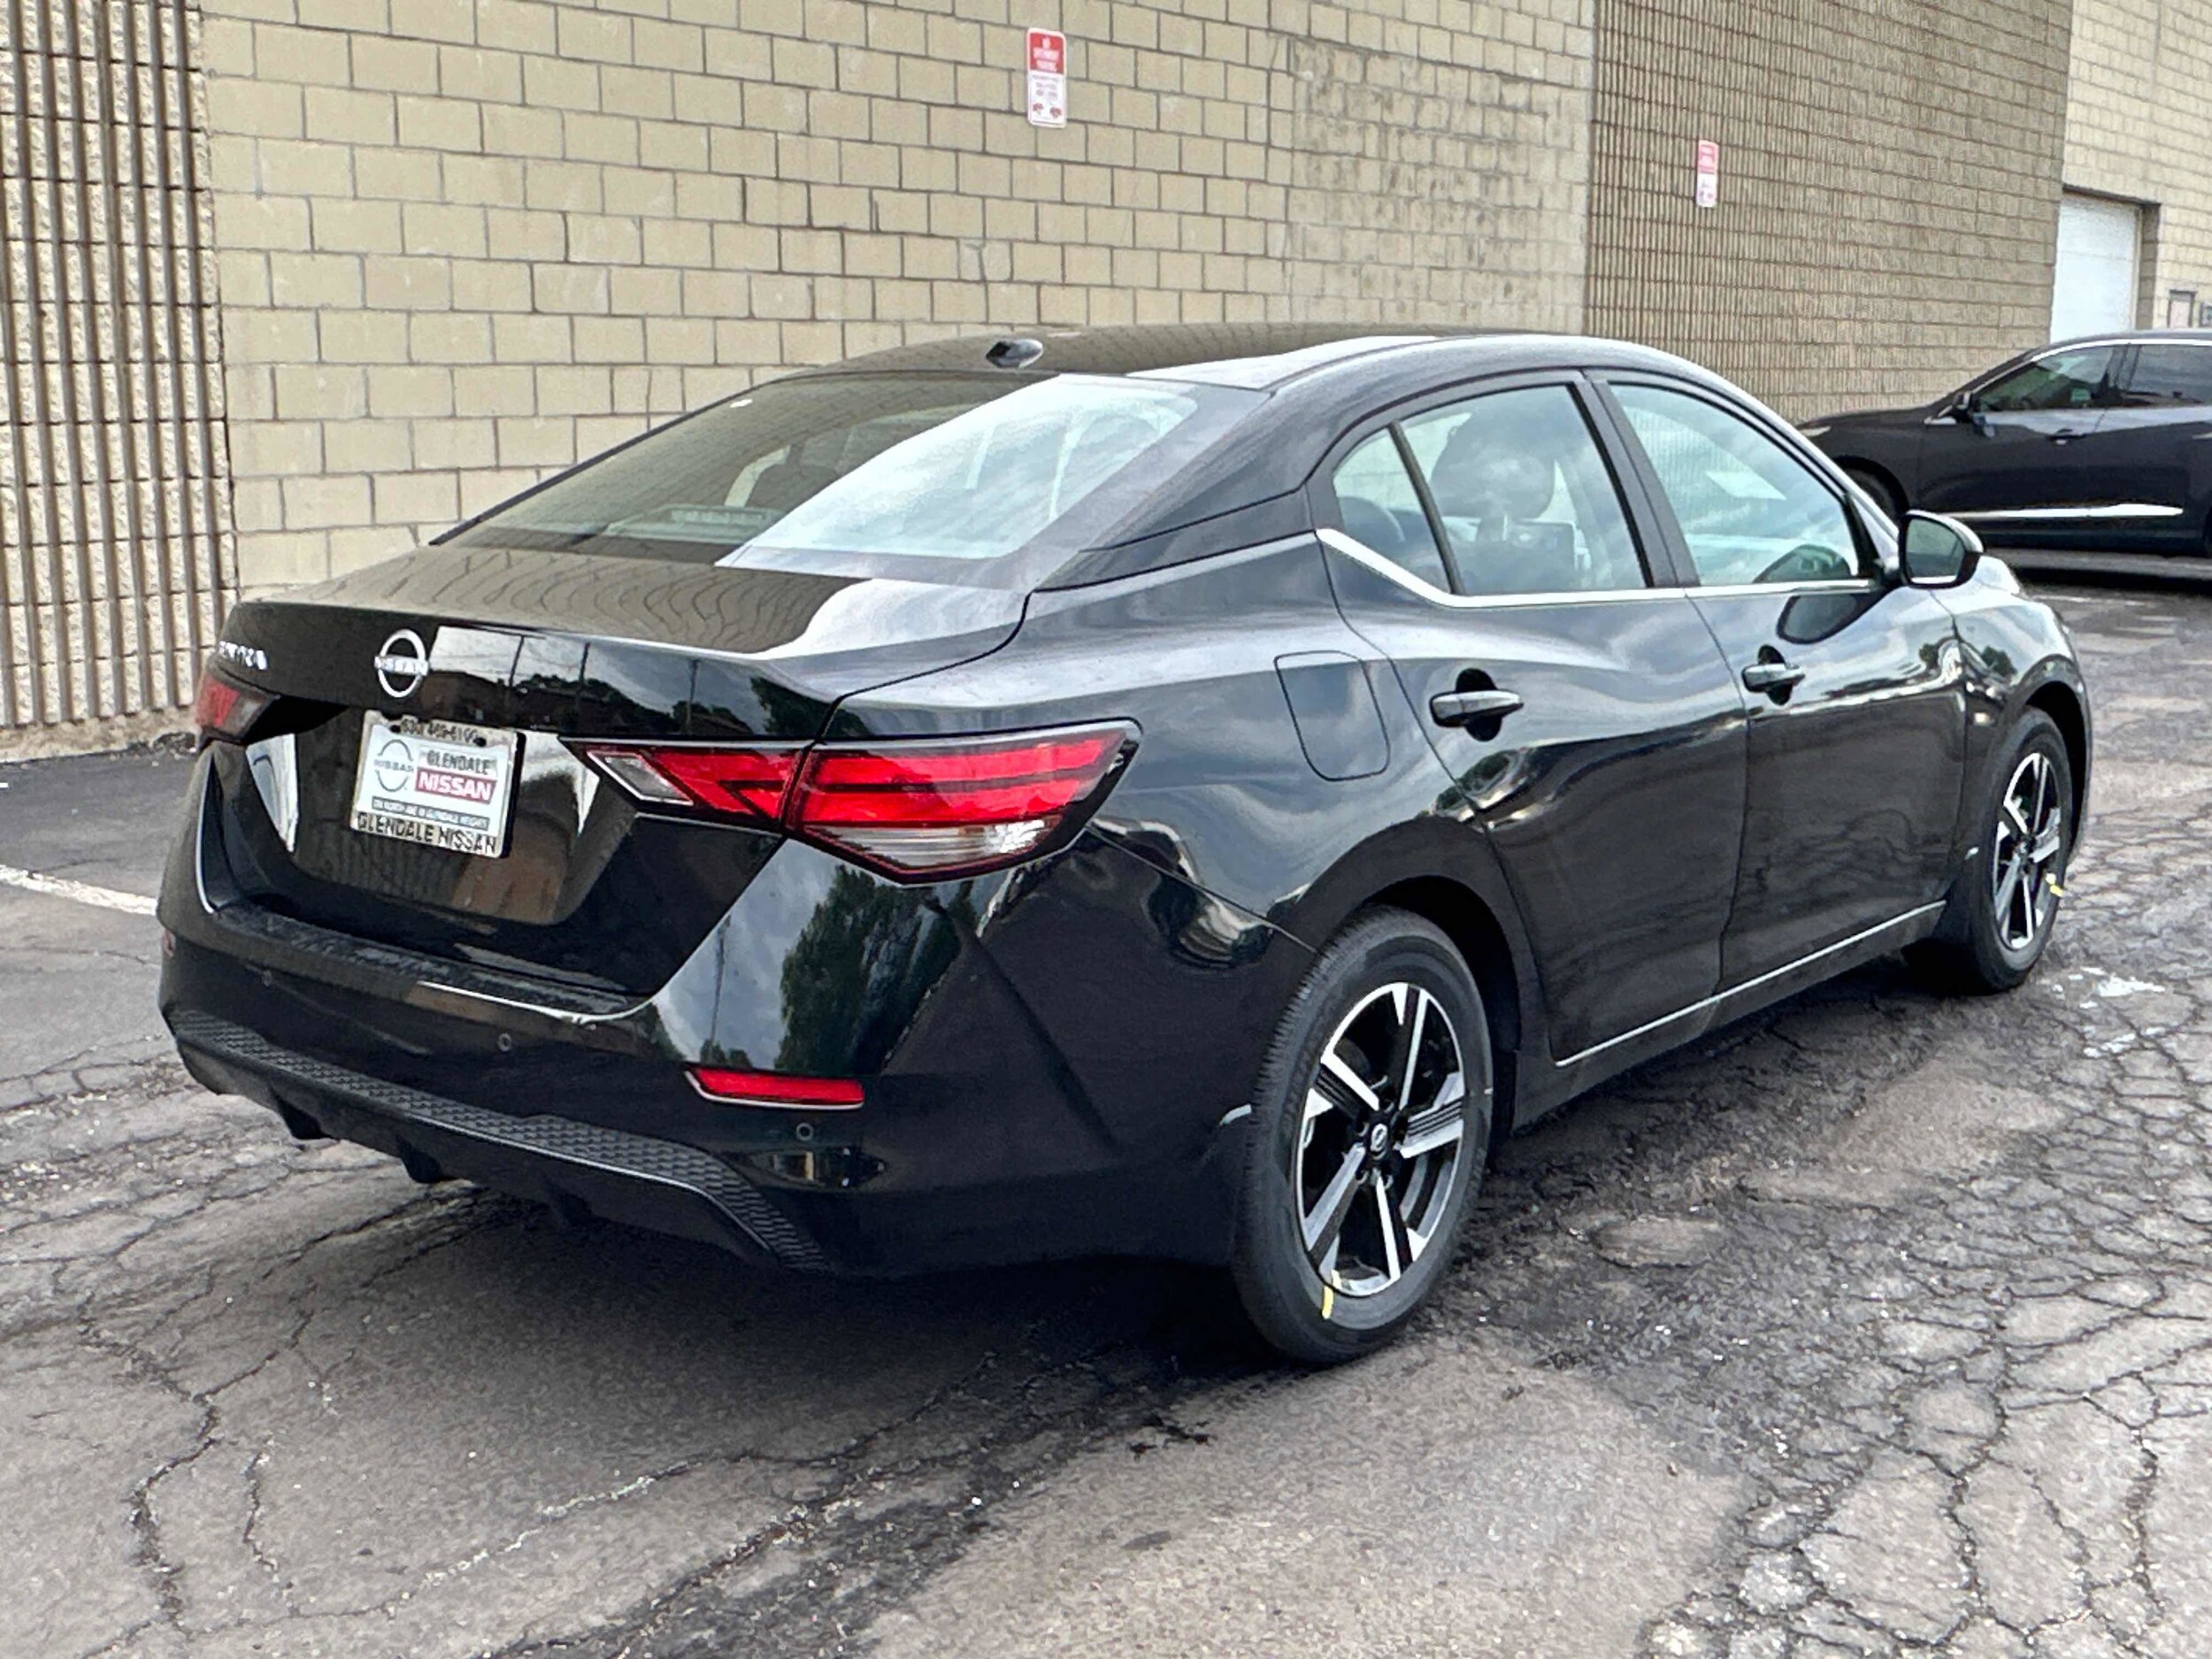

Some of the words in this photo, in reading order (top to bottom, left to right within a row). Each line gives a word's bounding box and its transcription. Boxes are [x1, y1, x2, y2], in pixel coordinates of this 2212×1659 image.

[426, 749, 490, 775] GLENDALE
[418, 772, 492, 800] NISSAN
[357, 812, 434, 842] GLENDALE
[438, 826, 496, 853] NISSAN
